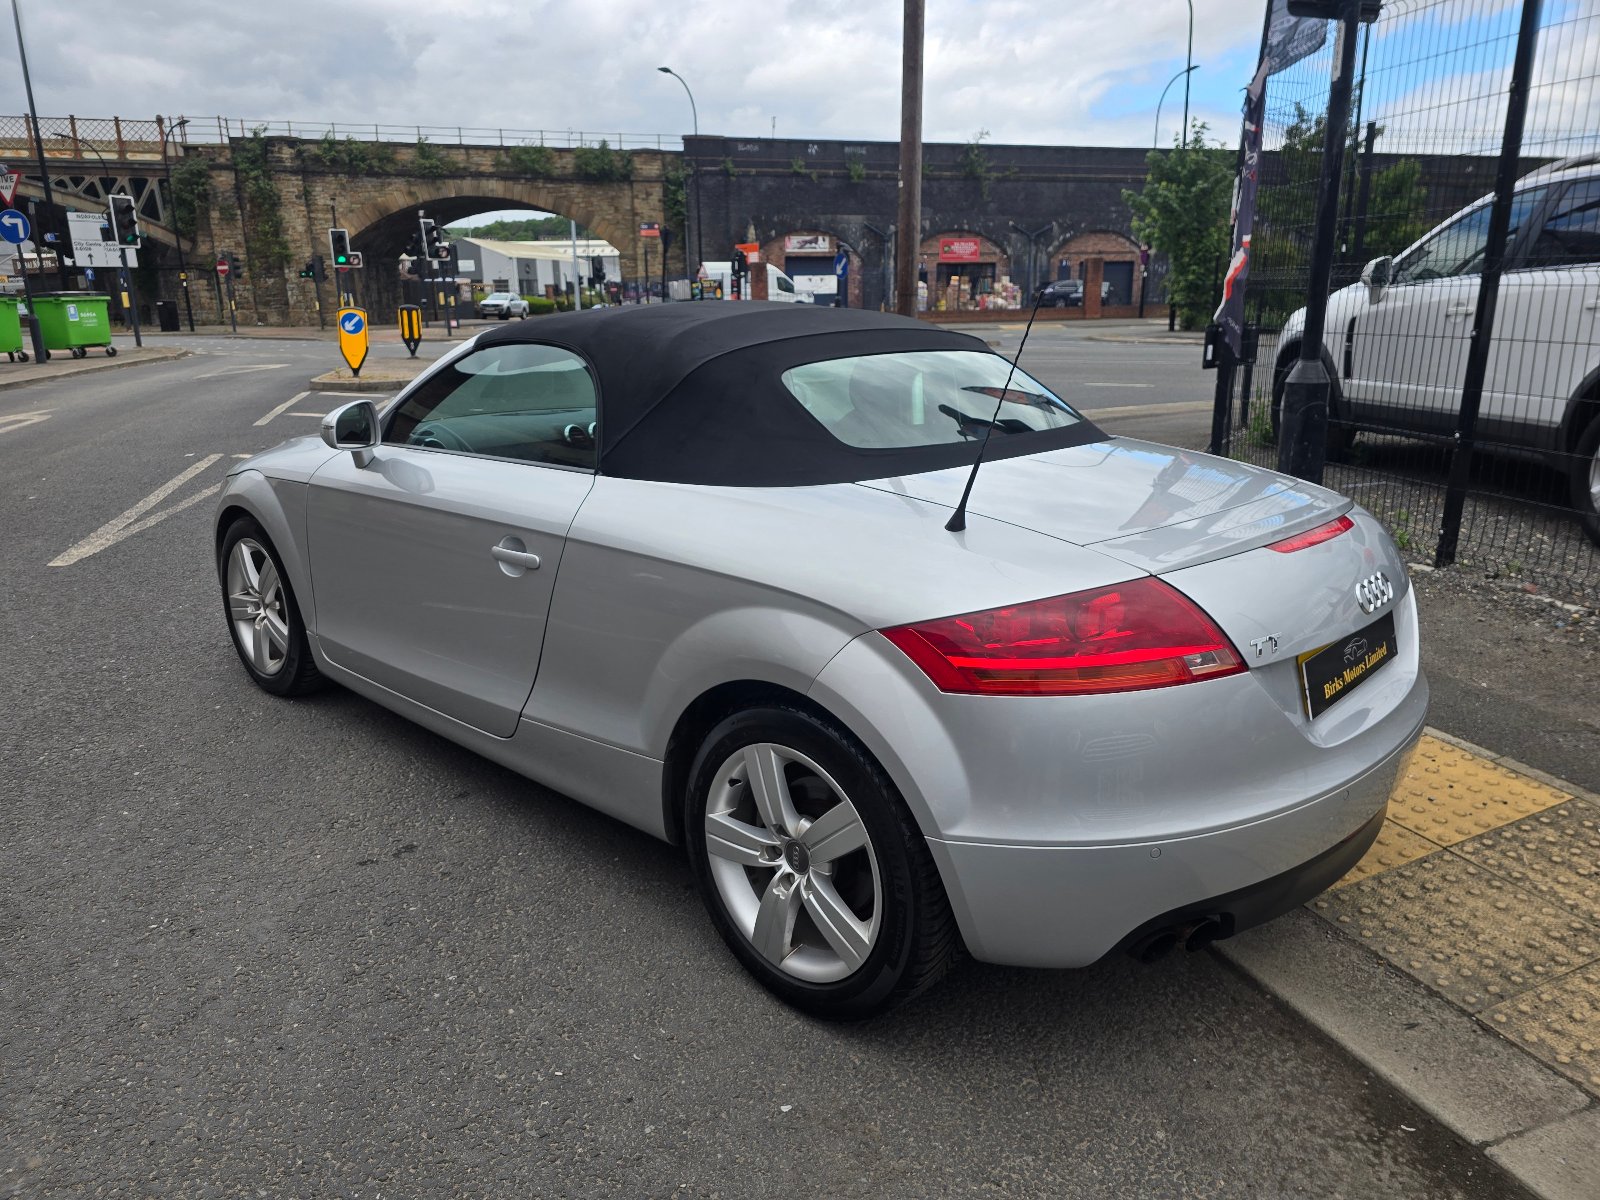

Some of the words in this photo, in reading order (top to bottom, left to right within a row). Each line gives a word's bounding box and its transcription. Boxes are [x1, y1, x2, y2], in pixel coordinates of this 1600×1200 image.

[0, 175, 14, 183] IVE
[1250, 632, 1281, 658] TT
[1324, 677, 1344, 699] Birks
[1343, 661, 1366, 685] Motors
[1365, 641, 1387, 669] Limited
